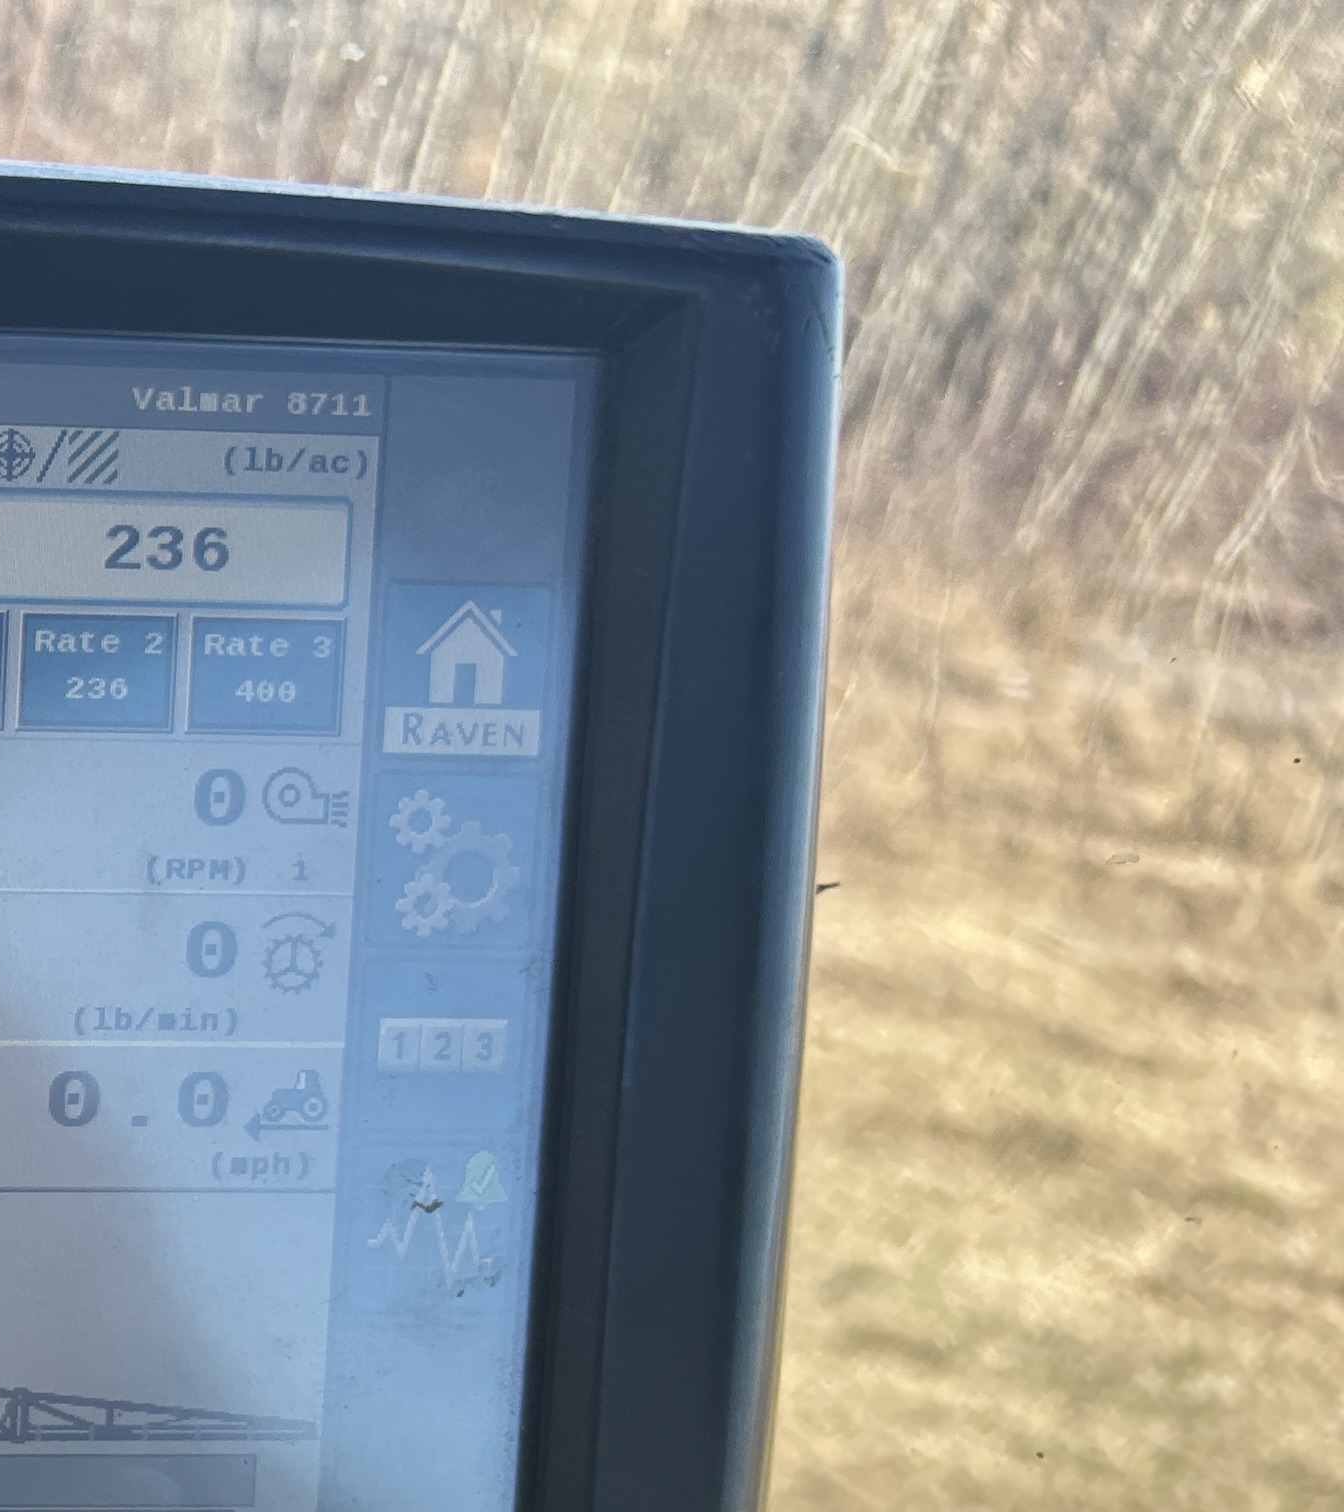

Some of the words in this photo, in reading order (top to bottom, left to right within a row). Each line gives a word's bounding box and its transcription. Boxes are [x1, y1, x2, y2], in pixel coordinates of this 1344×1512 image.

[132, 386, 264, 416] Valmar
[285, 390, 373, 418] 8711
[222, 447, 370, 481] (lb/ac)
[103, 525, 231, 574] 236
[33, 630, 122, 656] Rate
[142, 631, 165, 656] 2
[203, 633, 291, 660] Rate
[311, 635, 334, 661] 3
[64, 677, 130, 702] 236
[234, 679, 298, 705] 400
[400, 711, 525, 750] RAVEN
[193, 767, 248, 827] 0
[146, 856, 249, 885] (RPM)
[291, 860, 311, 882] 1
[184, 919, 239, 979] 0
[73, 1006, 240, 1036] (lb/min)
[47, 1069, 230, 1129] 0.0
[211, 1151, 312, 1183] (mph)
